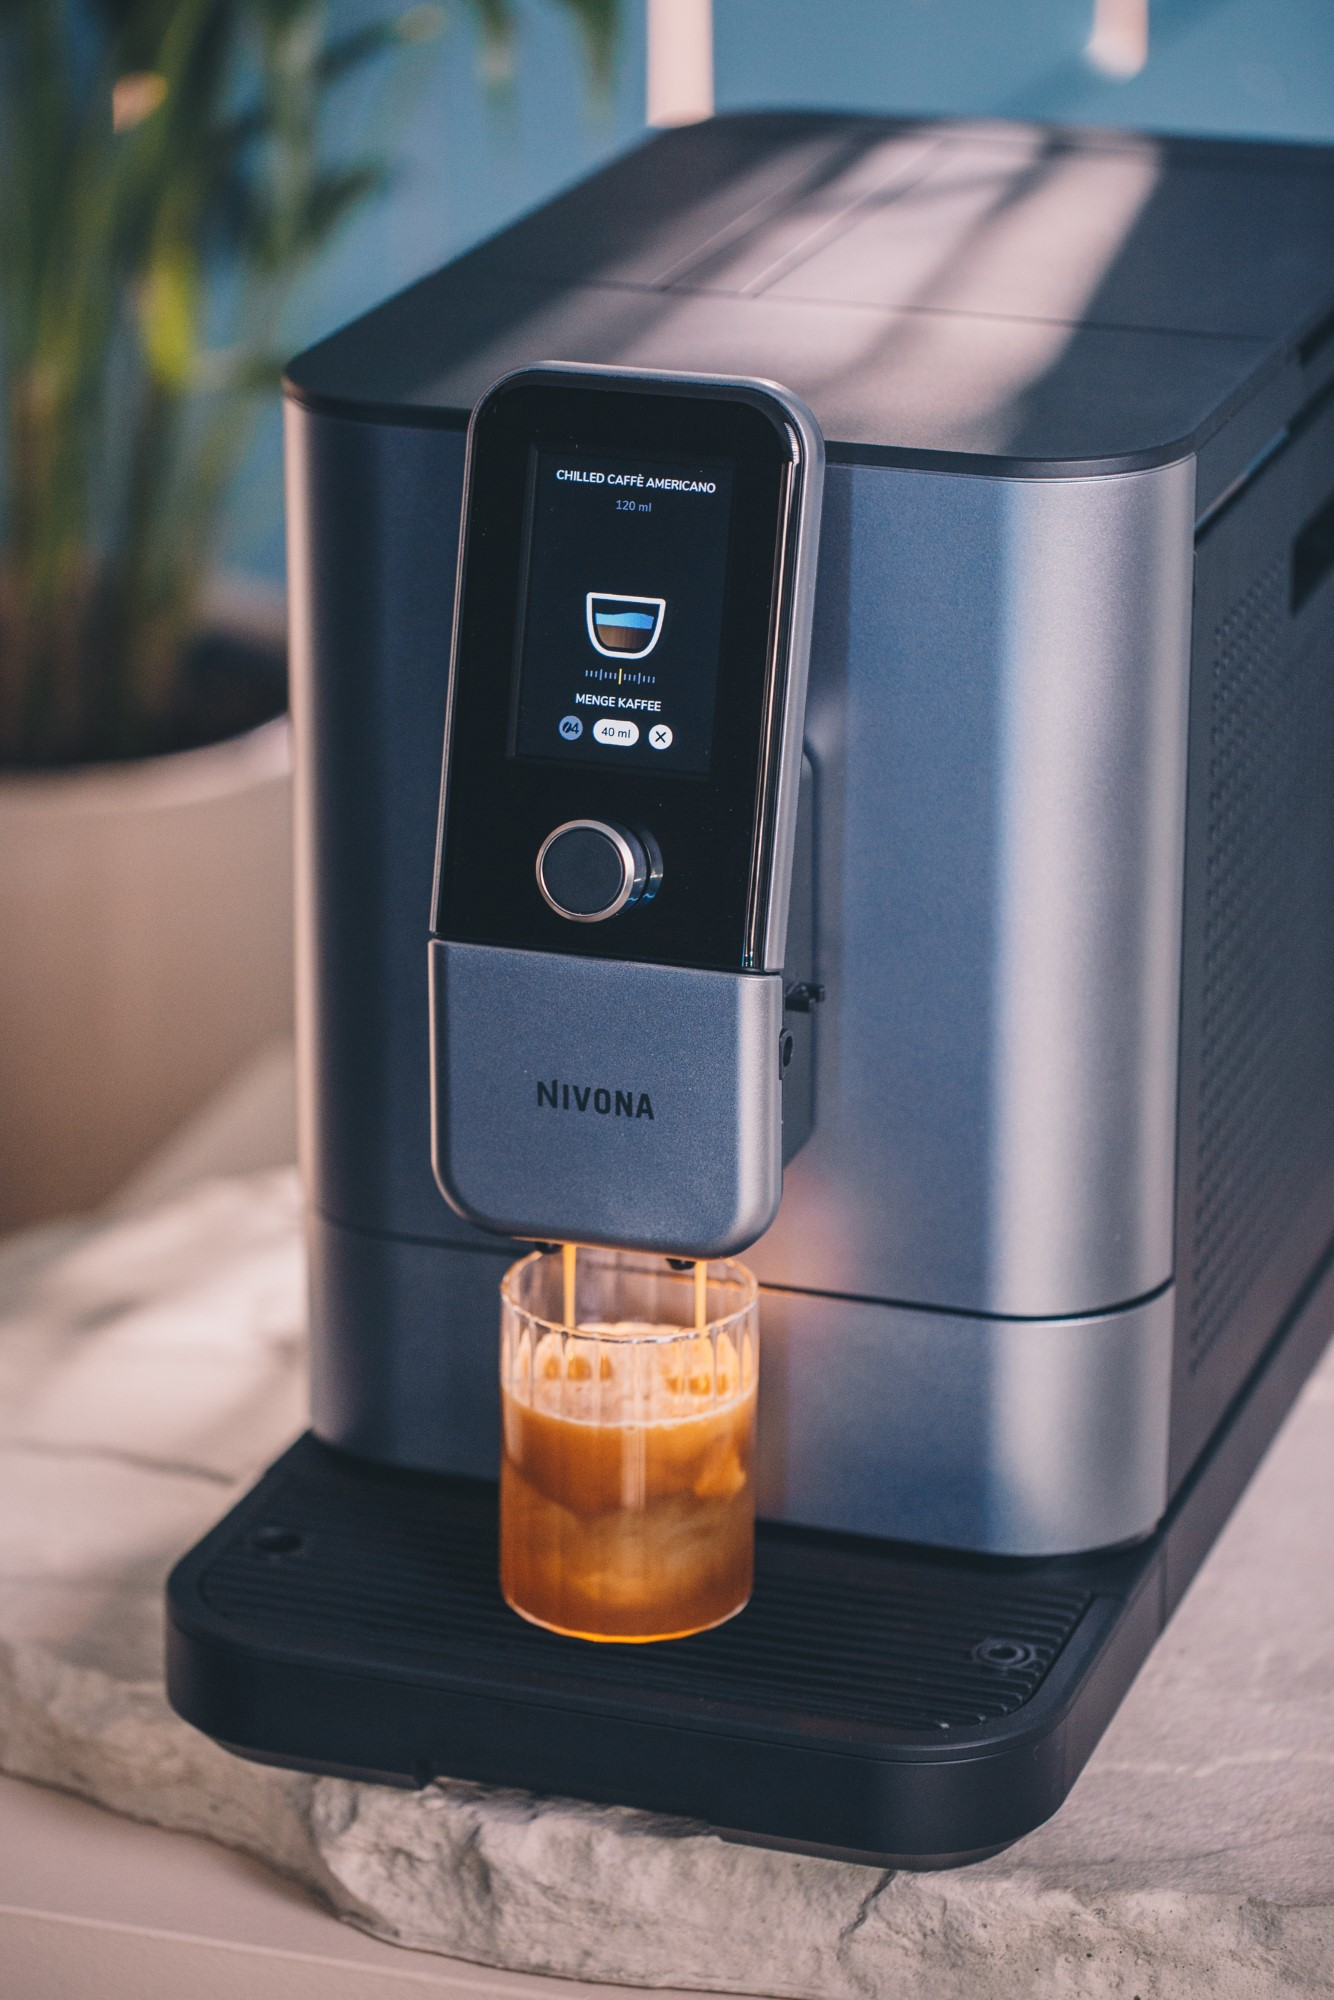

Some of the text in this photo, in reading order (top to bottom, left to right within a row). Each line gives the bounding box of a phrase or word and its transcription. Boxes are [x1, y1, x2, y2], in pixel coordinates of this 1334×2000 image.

[556, 469, 717, 494] CHILLED CAFFÈ AMERICANO
[615, 500, 652, 512] 120 ml
[575, 693, 662, 712] MENGE KAFFEE
[601, 727, 631, 739] 40 ml
[537, 1079, 654, 1120] NIVONA
